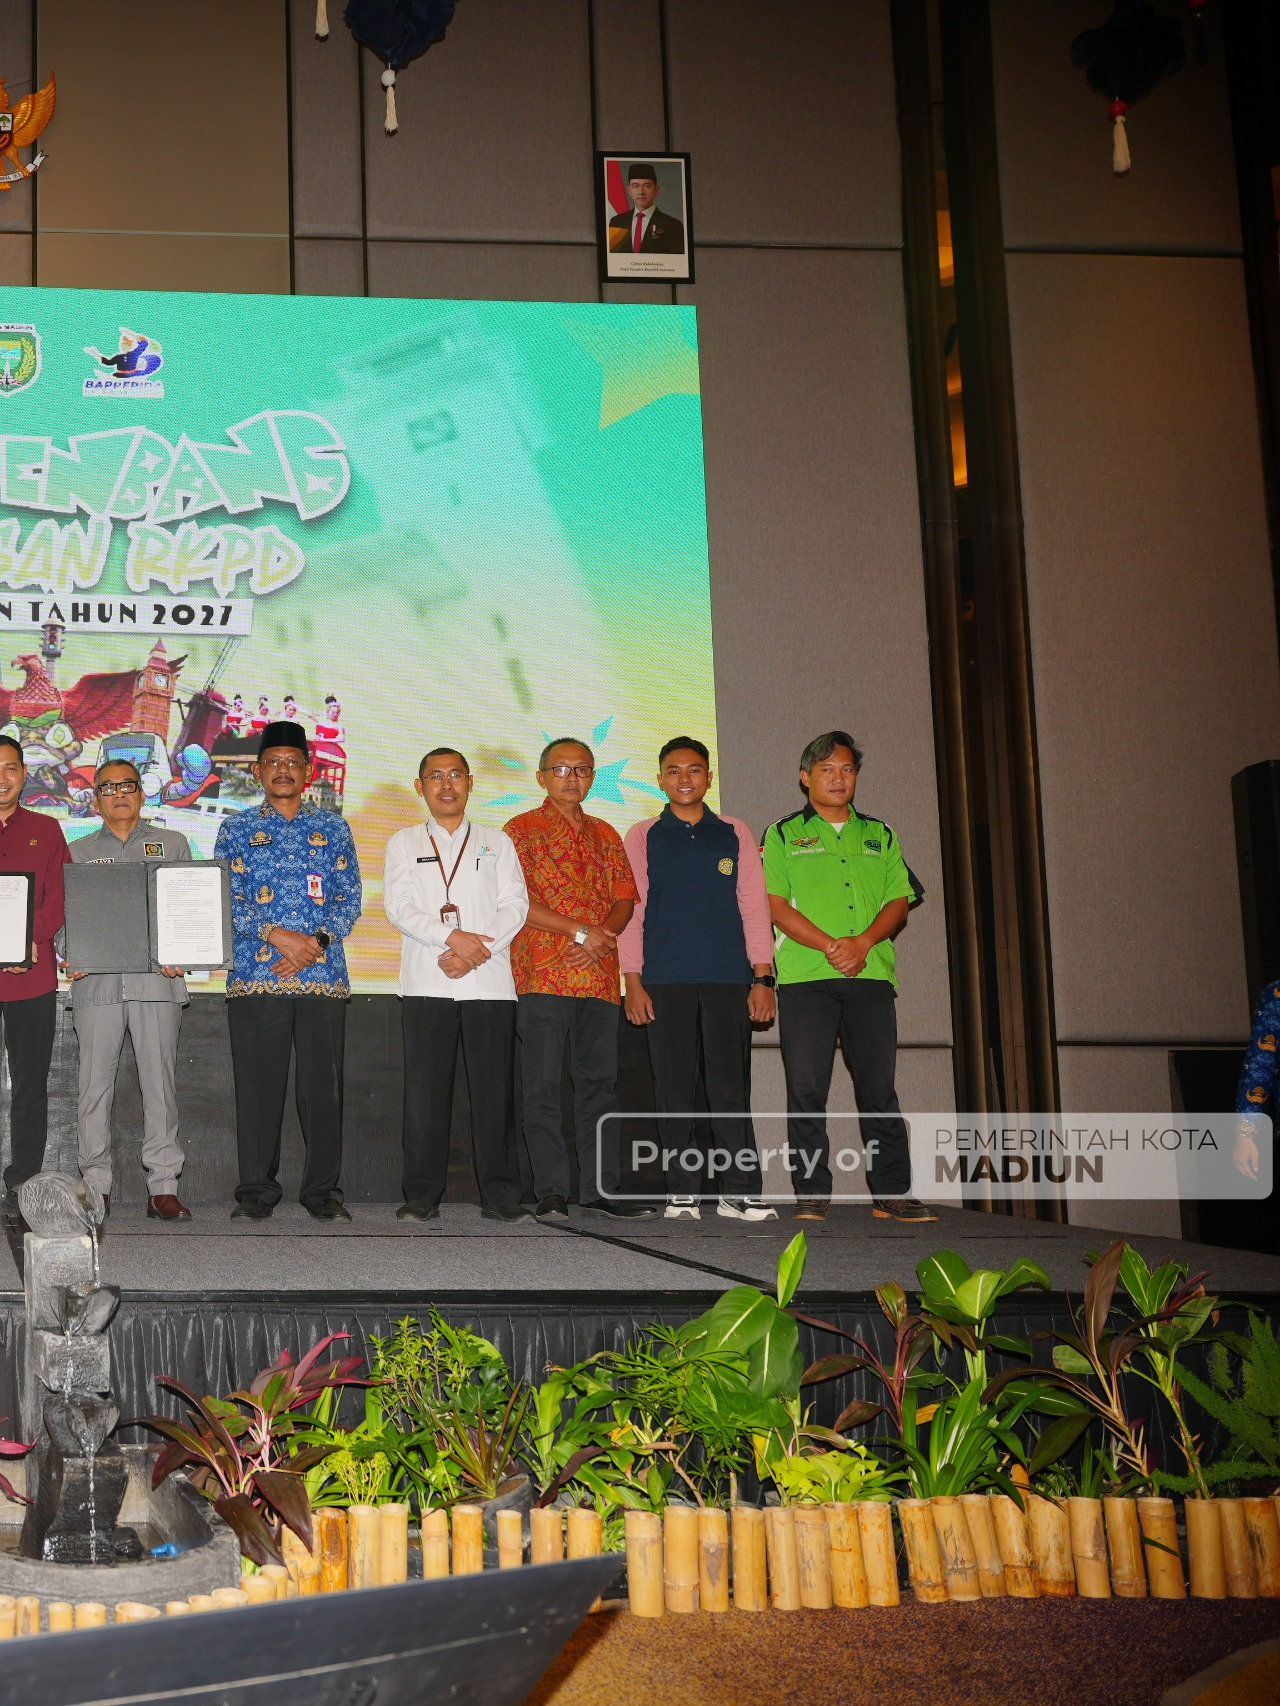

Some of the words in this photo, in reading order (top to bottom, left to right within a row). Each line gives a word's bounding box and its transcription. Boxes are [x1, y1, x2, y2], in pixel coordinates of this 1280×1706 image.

[126, 520, 306, 599] RKPD
[28, 600, 137, 624] TAHUN
[152, 602, 233, 626] 2027
